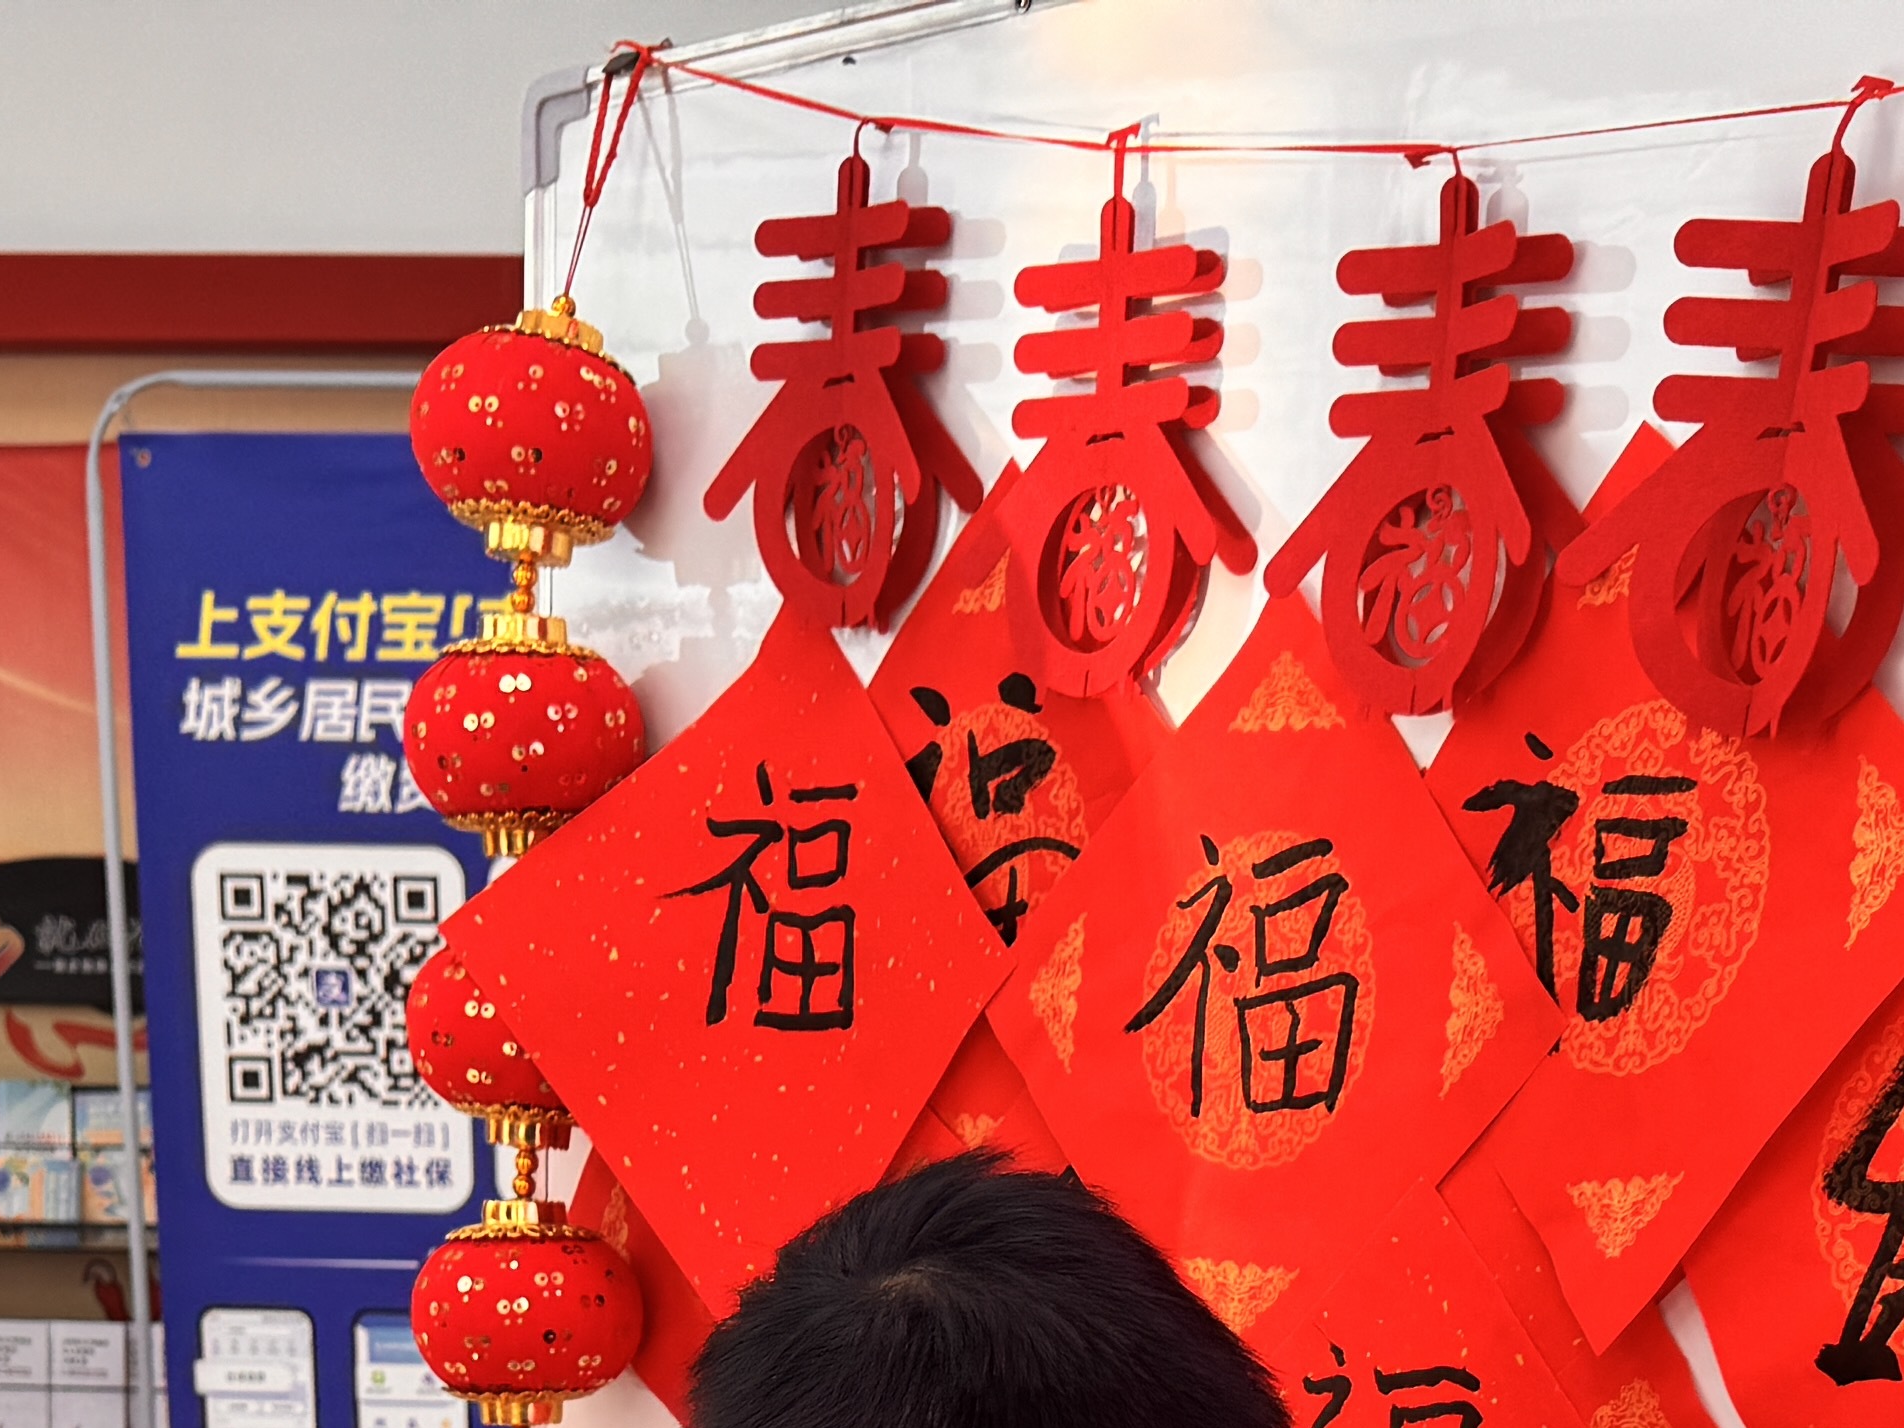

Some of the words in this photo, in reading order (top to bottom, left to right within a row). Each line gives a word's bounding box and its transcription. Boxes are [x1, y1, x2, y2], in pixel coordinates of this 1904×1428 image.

[664, 760, 858, 1032] 福
[1124, 835, 1361, 1118] 福
[1460, 732, 1700, 1023] 福
[229, 1154, 454, 1188] 直接线上缴社保
